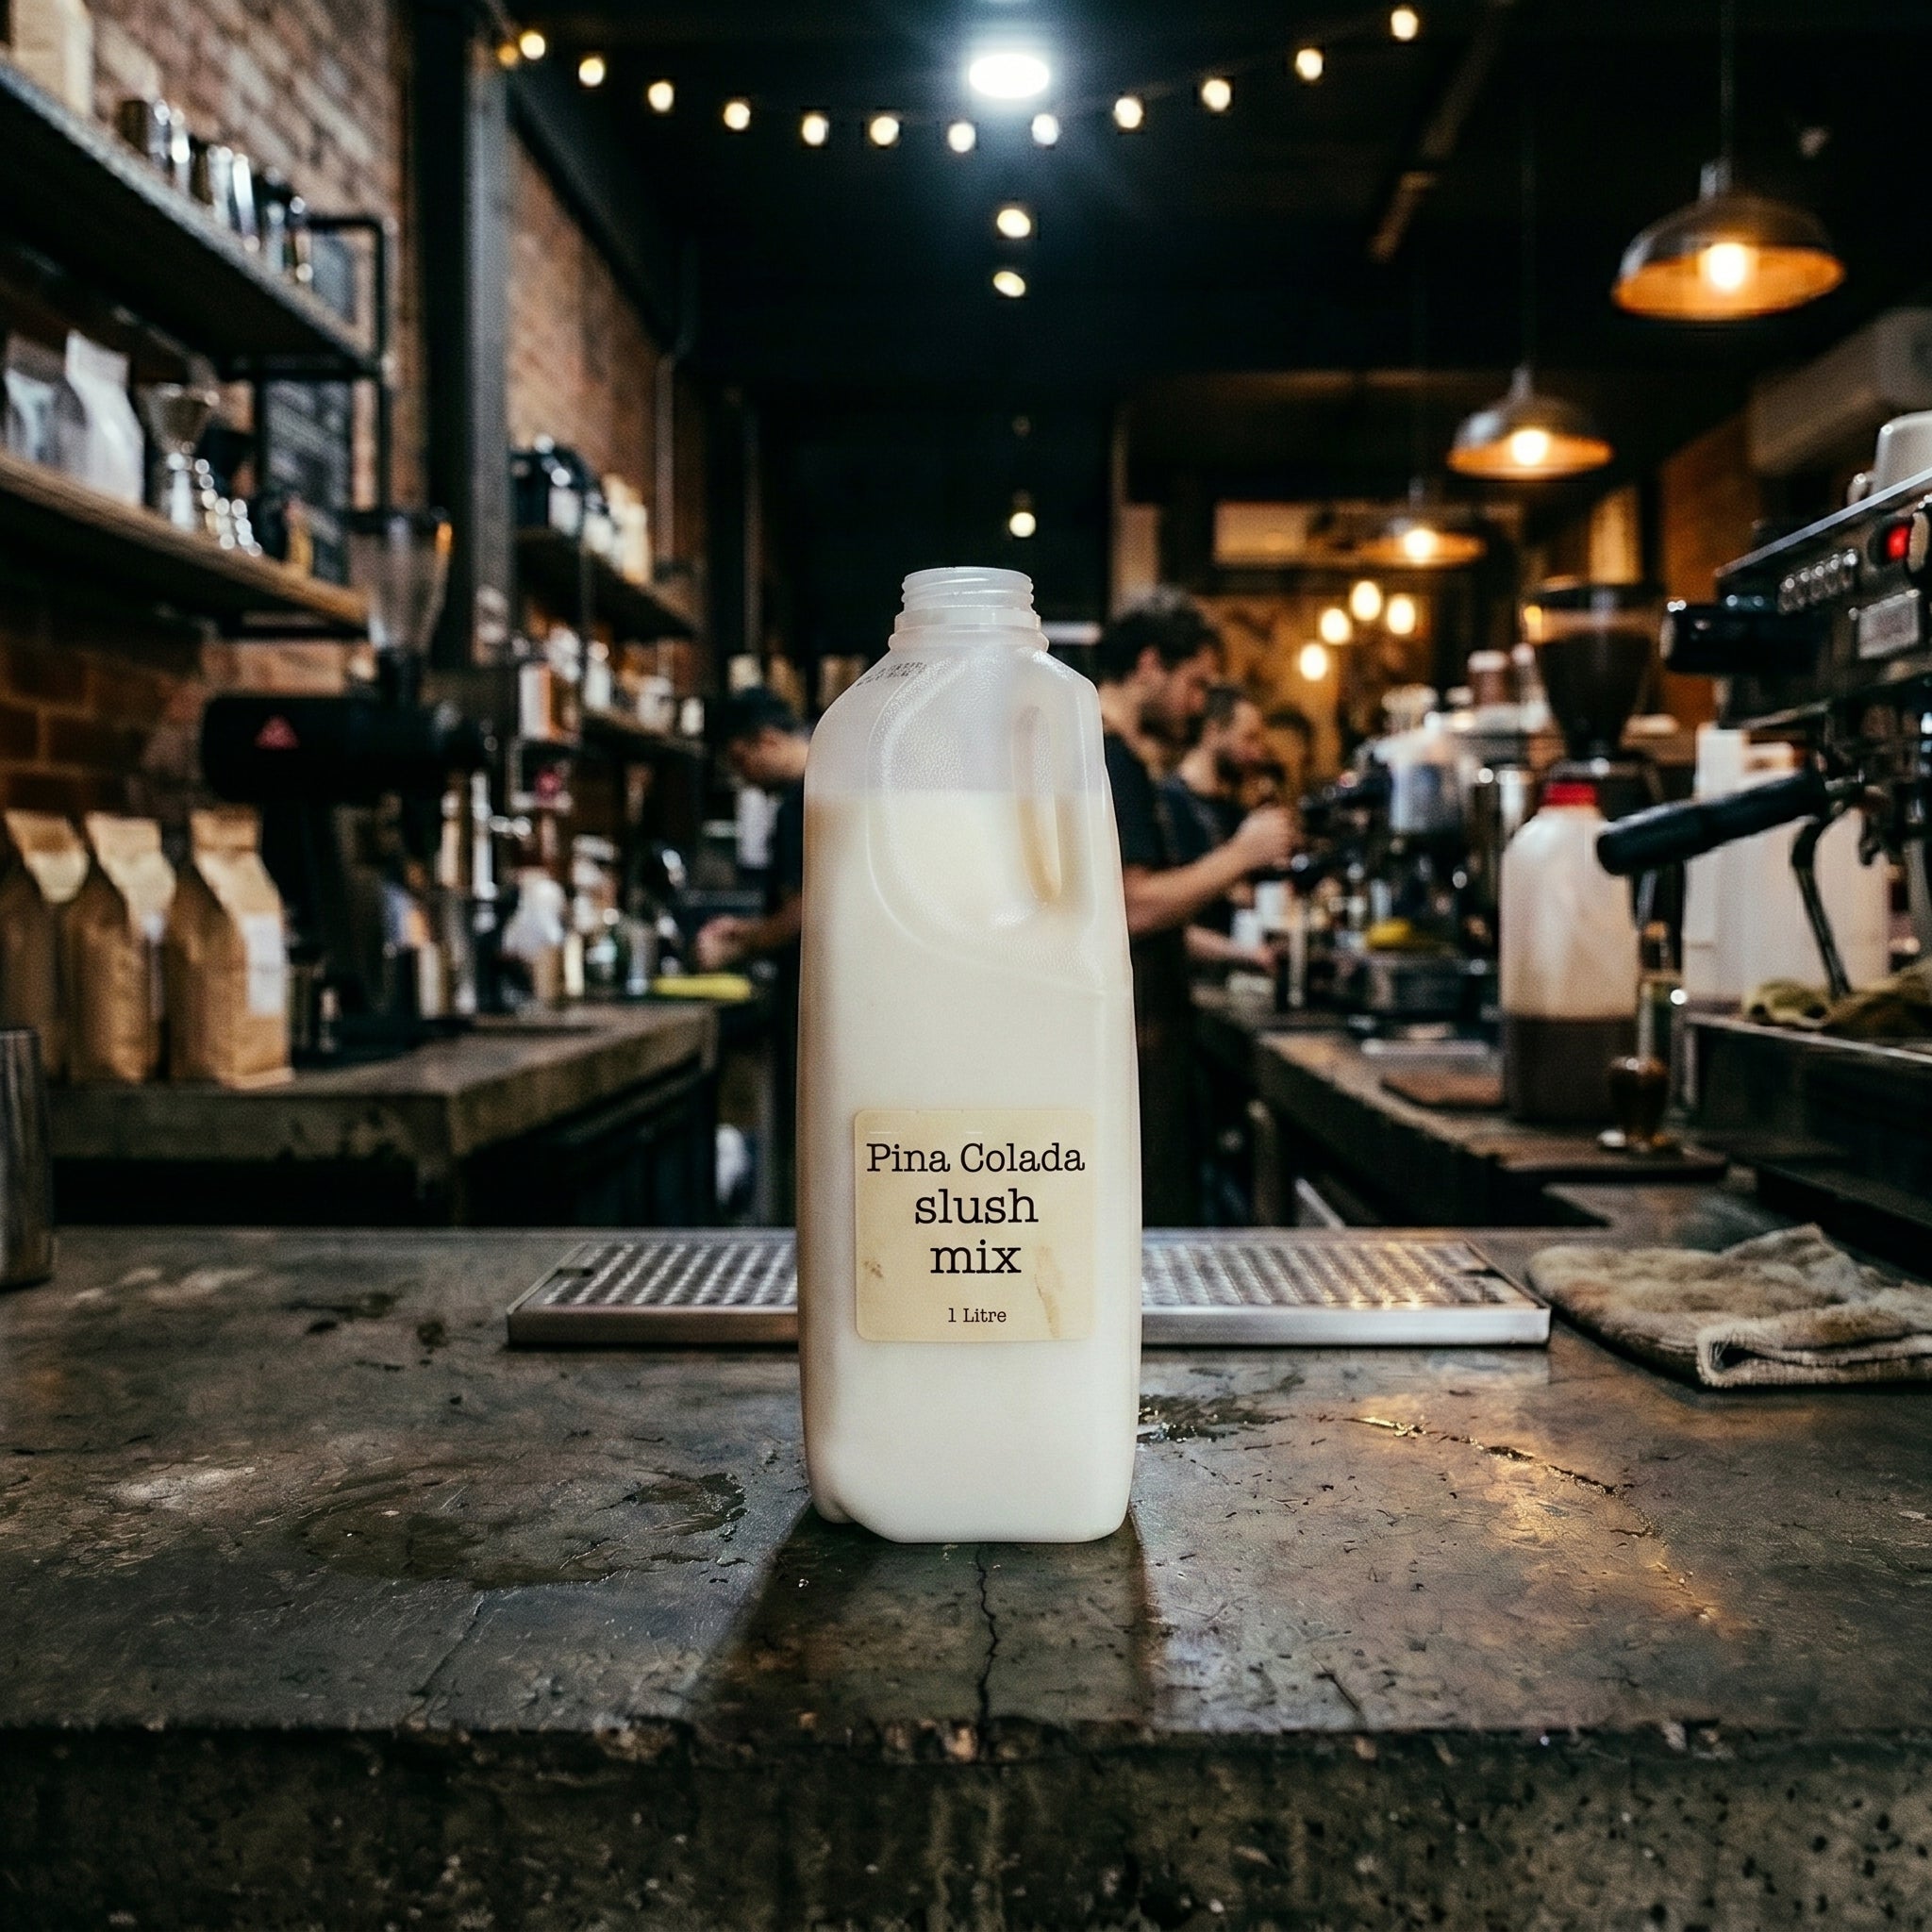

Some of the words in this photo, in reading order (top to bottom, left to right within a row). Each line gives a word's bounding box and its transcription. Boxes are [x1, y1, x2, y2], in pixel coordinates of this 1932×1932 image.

[866, 1142, 950, 1173] Pina
[960, 1142, 1086, 1173] Colada
[915, 1188, 1039, 1224] slush
[930, 1239, 1022, 1274] mix
[948, 1307, 957, 1323] 1
[963, 1307, 1007, 1323] Litre
